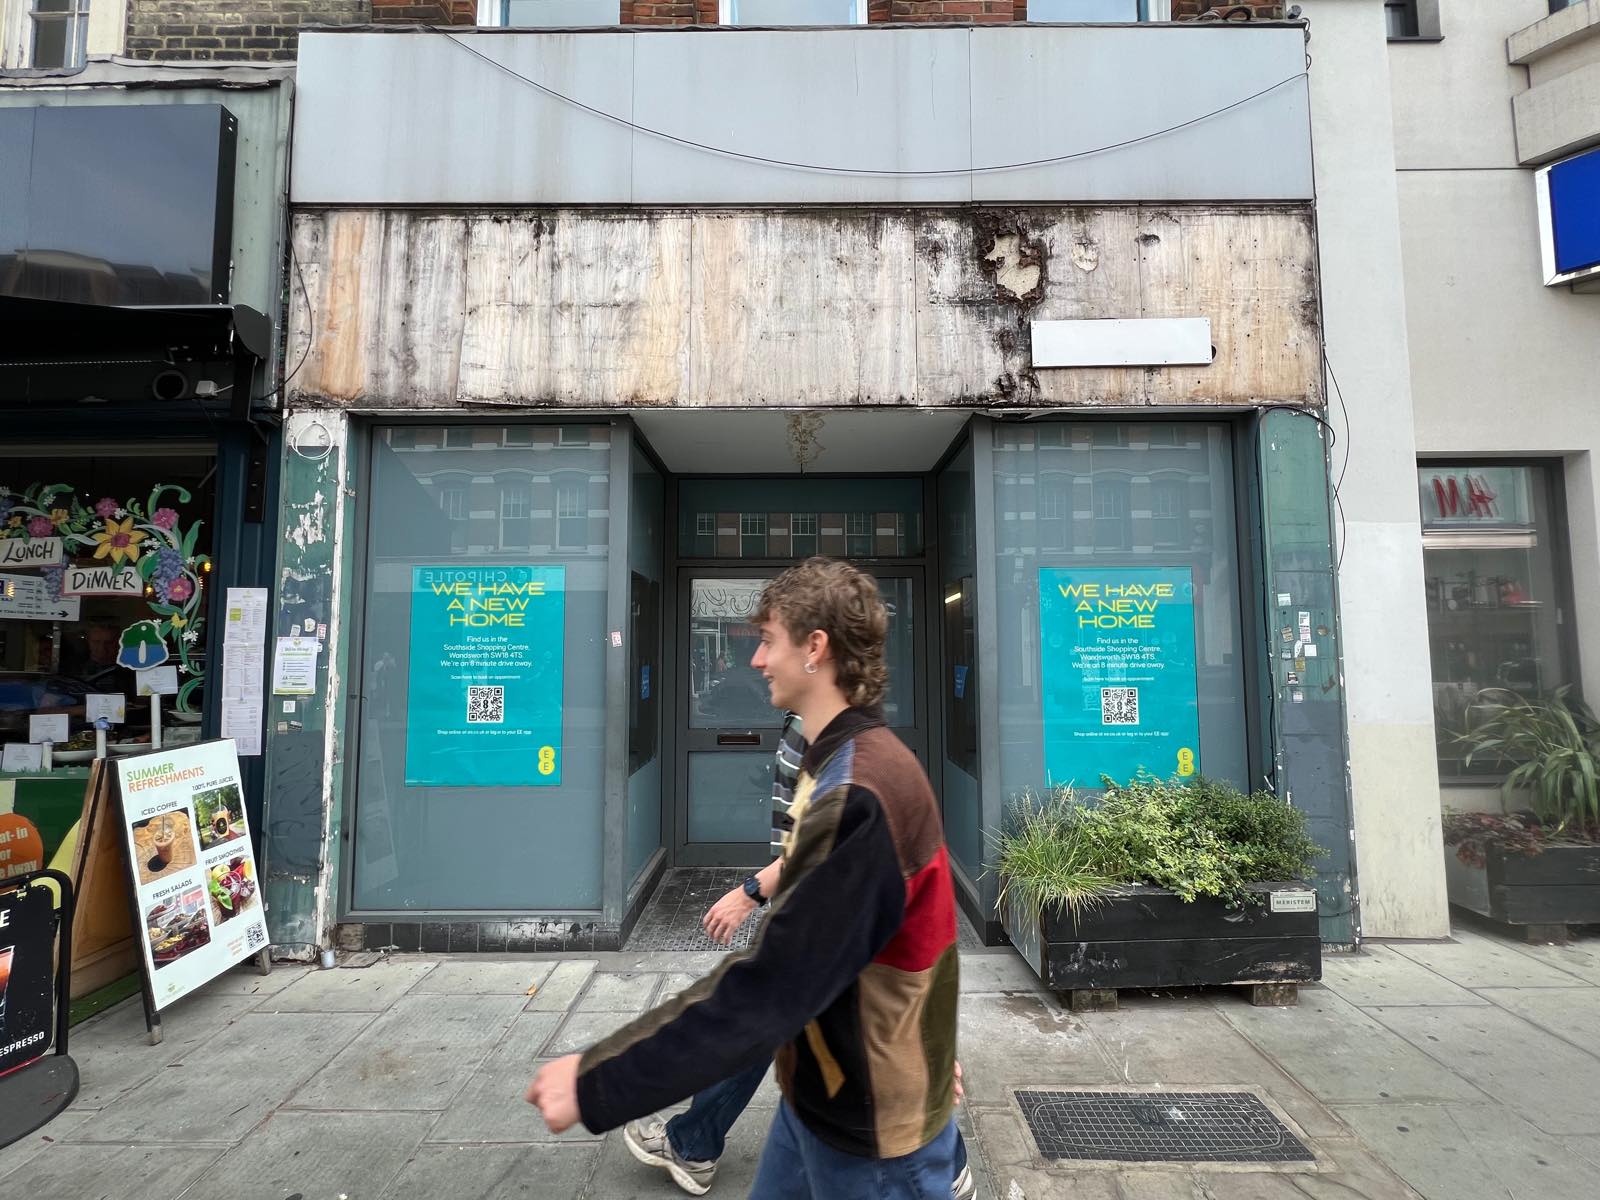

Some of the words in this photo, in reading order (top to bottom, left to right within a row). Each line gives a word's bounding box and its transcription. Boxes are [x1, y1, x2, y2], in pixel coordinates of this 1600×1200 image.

[3, 541, 55, 563] LUNCH
[431, 582, 473, 596] WE
[478, 582, 545, 596] HAVE
[1058, 584, 1100, 597] WE
[1105, 584, 1174, 597] HAVE
[446, 597, 465, 611] A
[470, 597, 530, 611] NEW
[1074, 599, 1094, 613] A
[1098, 599, 1158, 613] NEW
[450, 613, 526, 627] HOME
[1079, 615, 1155, 629] HOME
[126, 762, 175, 782] SUMMER
[128, 766, 205, 793] REFRESHMENTS
[192, 783, 206, 792] 100%
[206, 778, 218, 788] PURE
[141, 808, 156, 816] ICED
[156, 801, 178, 812] COFFEE
[205, 856, 219, 866] FRUIT
[152, 887, 170, 900] FRESH
[170, 879, 193, 892] SALADS
